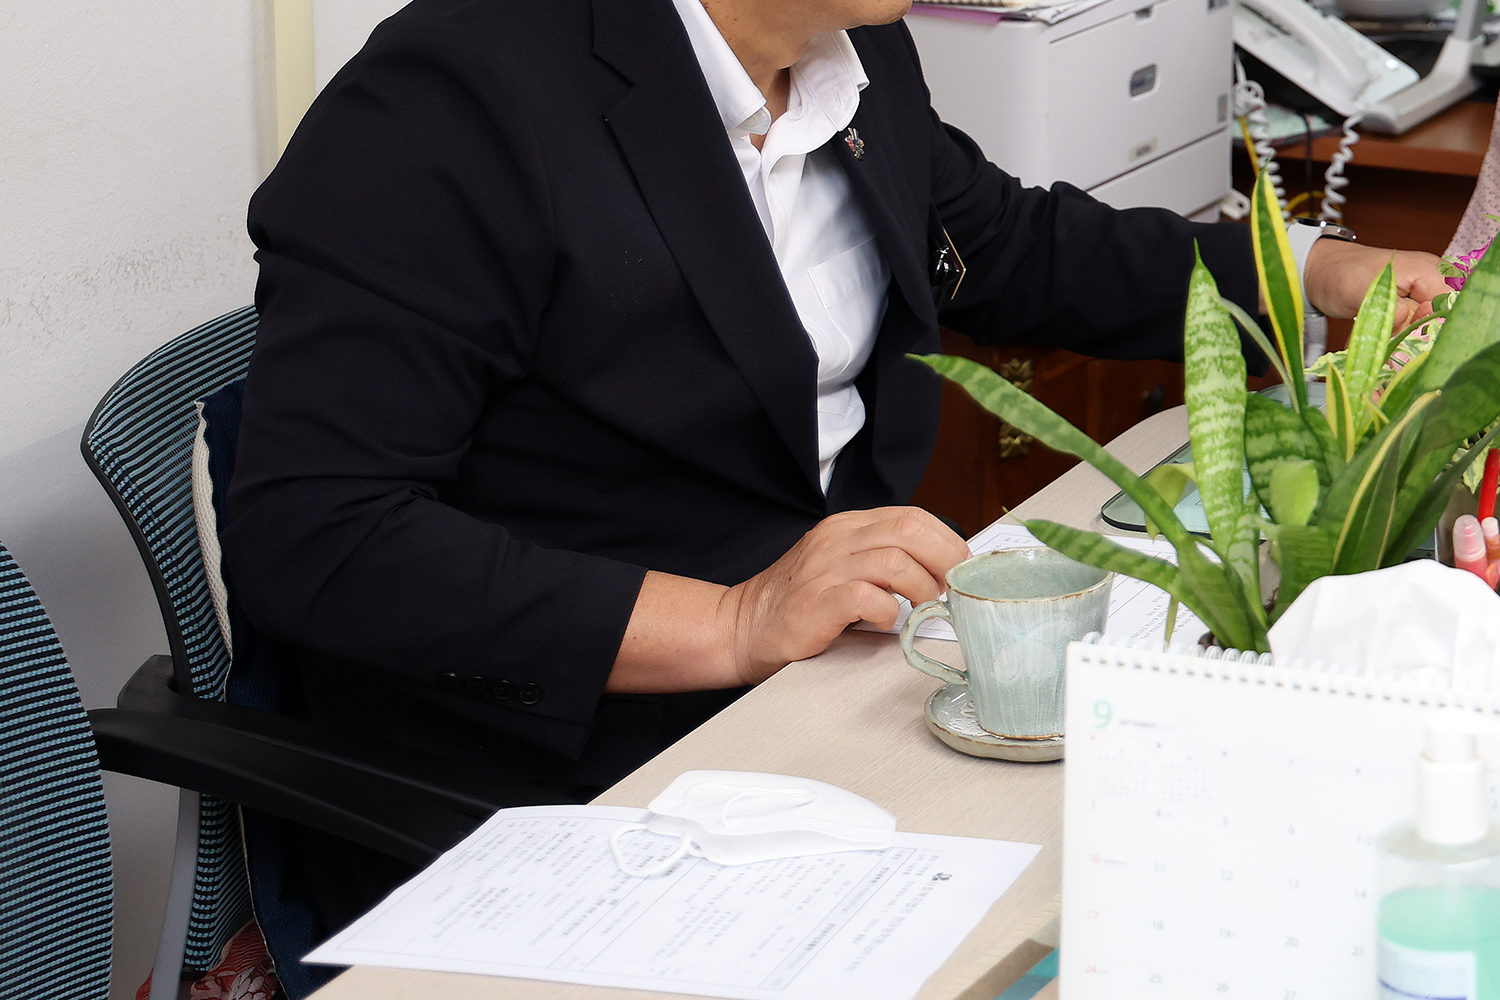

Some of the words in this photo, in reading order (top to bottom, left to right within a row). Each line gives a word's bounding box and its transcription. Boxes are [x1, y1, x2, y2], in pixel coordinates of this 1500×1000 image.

[1092, 699, 1112, 730] 9
[1154, 808, 1162, 818] 4
[1287, 823, 1295, 835] 6
[1354, 832, 1362, 844] 7
[1089, 852, 1102, 865] 10
[1153, 860, 1166, 873] 11
[1220, 869, 1233, 882] 12
[1287, 877, 1300, 889] 13
[1354, 887, 1367, 899] 14
[1087, 909, 1100, 920] 17
[1151, 919, 1165, 931] 18
[1218, 927, 1231, 939] 19
[1284, 935, 1299, 948] 20
[1351, 945, 1364, 957] 21
[1148, 972, 1162, 984] 25
[1215, 980, 1229, 993] 26
[1282, 989, 1297, 1000] 27
